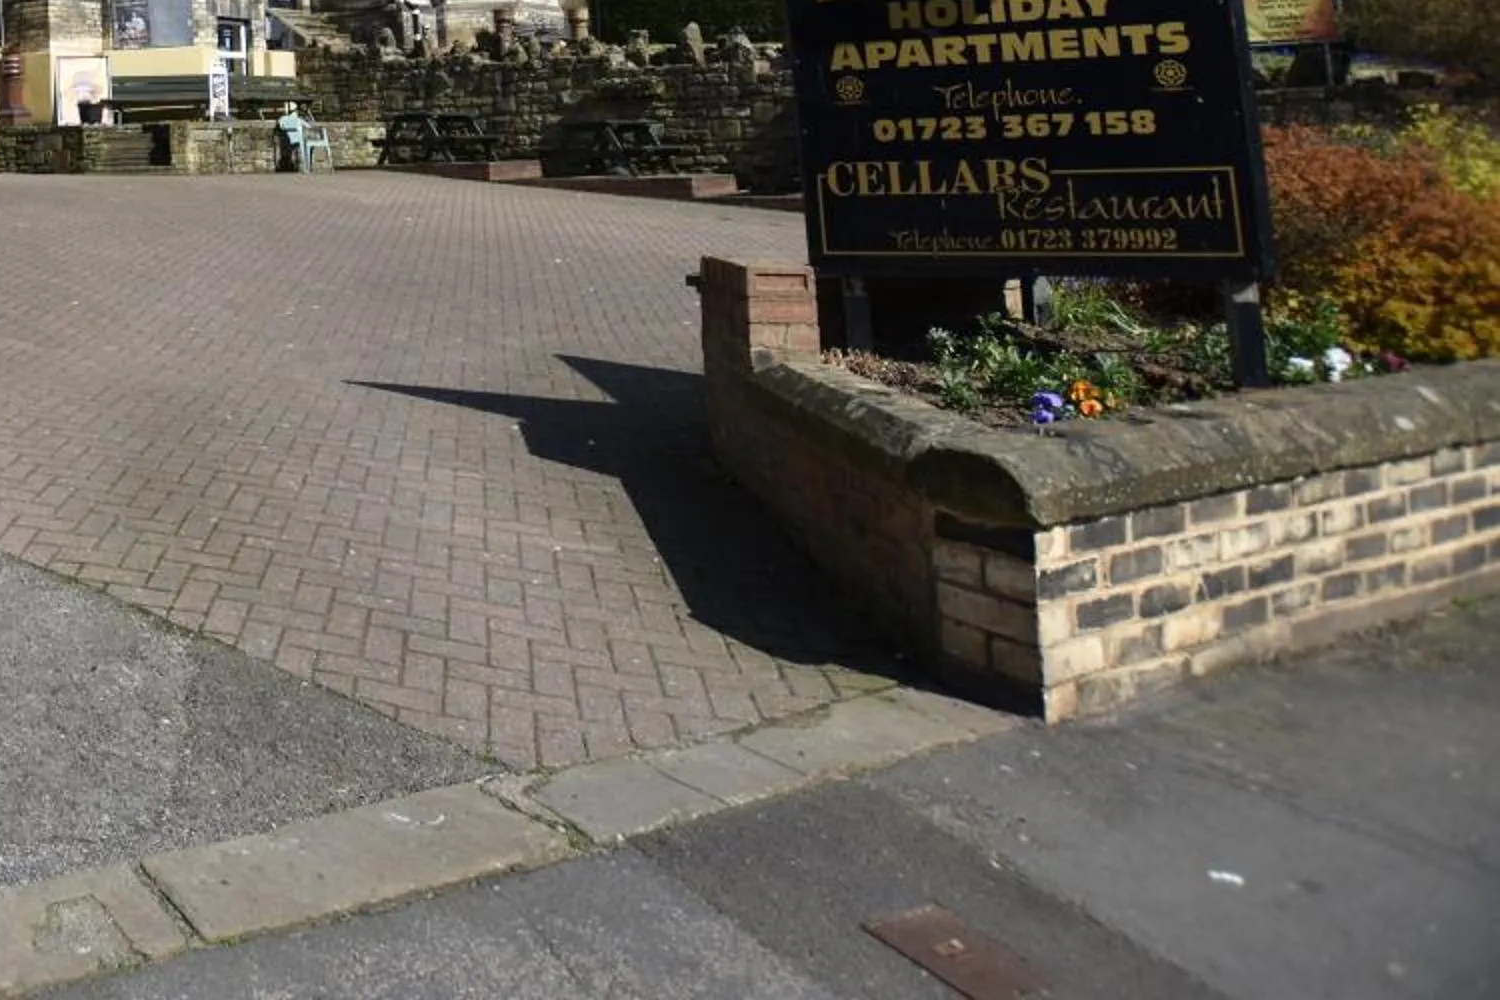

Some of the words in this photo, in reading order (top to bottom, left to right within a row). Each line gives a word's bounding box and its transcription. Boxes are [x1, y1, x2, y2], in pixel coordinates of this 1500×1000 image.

[830, 21, 1191, 71] APARTMENTS
[873, 114, 987, 142] 01723
[1002, 112, 1073, 140] 367
[1084, 109, 1156, 137] 158
[826, 158, 1052, 198] CELLARS
[997, 175, 1227, 222] Restaurant
[1000, 228, 1073, 251] 01723
[1081, 228, 1178, 251] 379992
